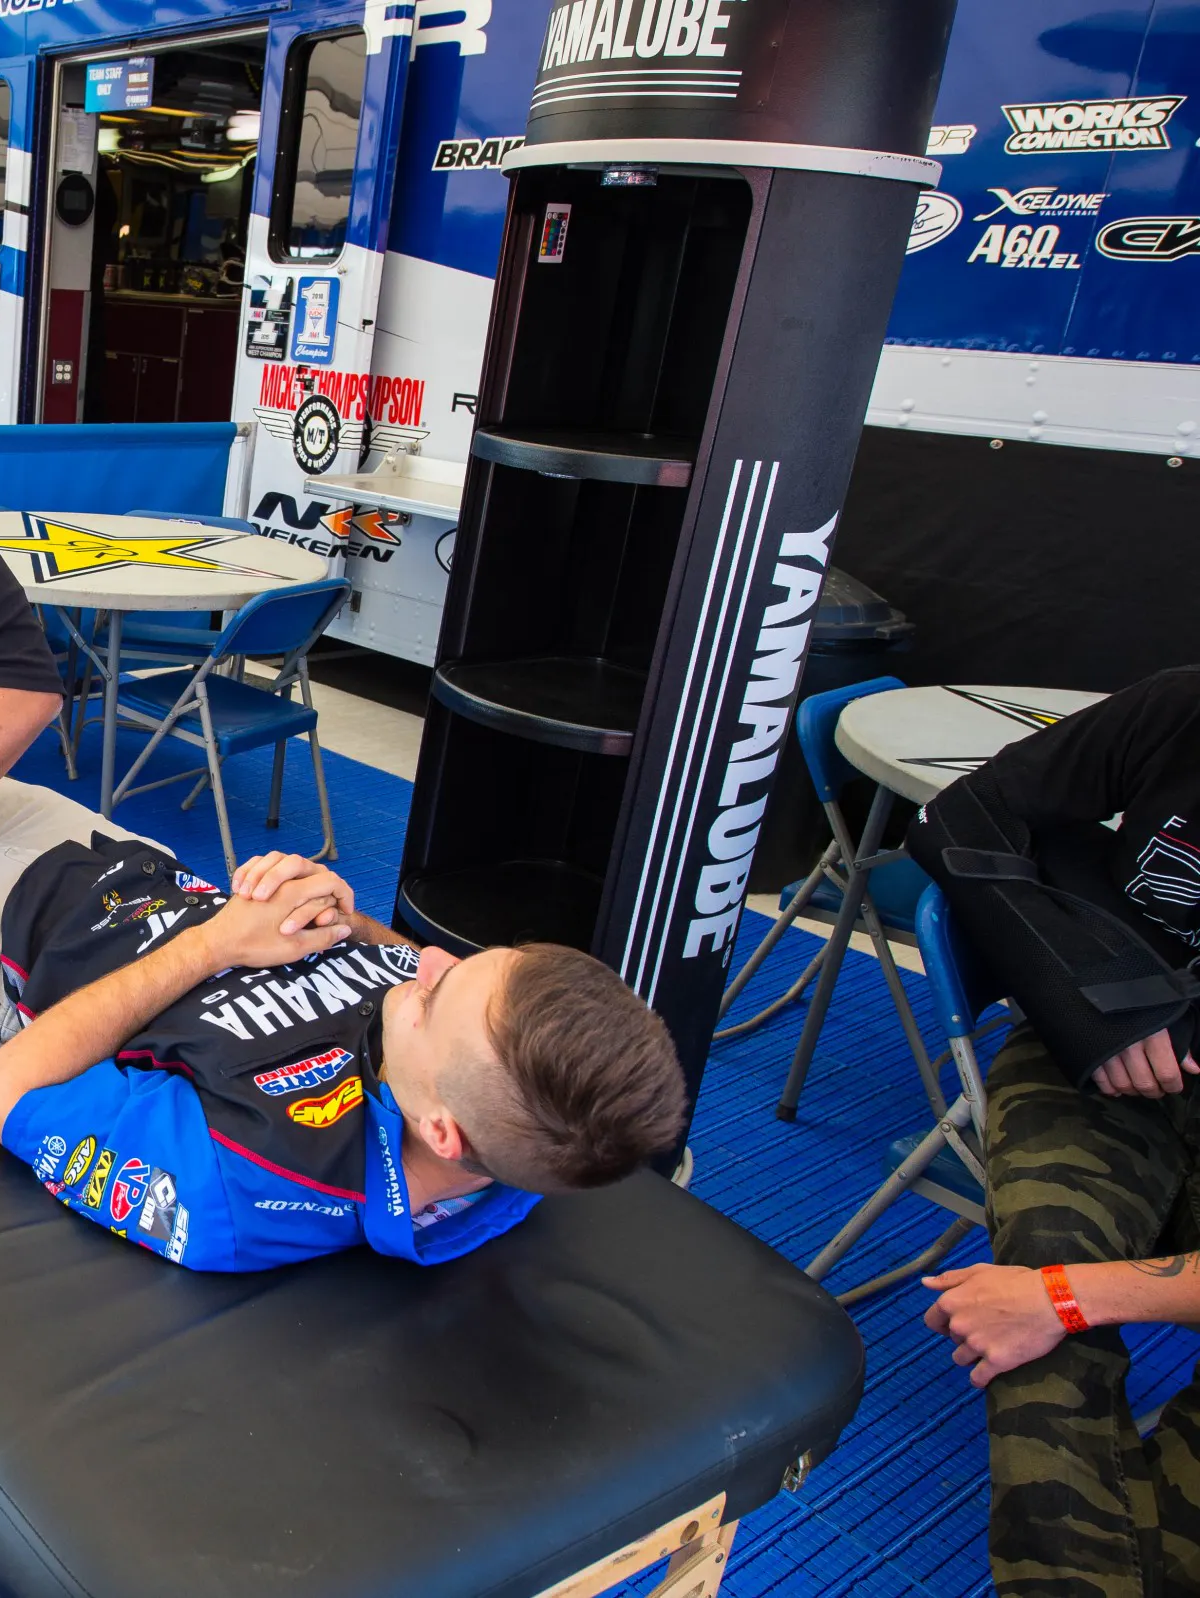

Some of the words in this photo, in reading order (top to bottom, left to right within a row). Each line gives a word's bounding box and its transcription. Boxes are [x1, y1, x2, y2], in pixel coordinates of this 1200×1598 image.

[542, 0, 731, 71] YAMALUBE
[105, 66, 123, 80] STAFF
[1008, 100, 1178, 133] WORKS
[1008, 127, 1162, 150] CONNECTION
[972, 186, 1107, 222] XCELDYNE
[1039, 209, 1099, 217] VALVETRAIN
[966, 224, 1061, 264] A60
[1000, 253, 1082, 269] EXCEL
[295, 344, 329, 359] Champion
[681, 508, 840, 960] YAMALUBE
[198, 948, 404, 1041] YAMAHA
[254, 1048, 347, 1085] UNLIMITED
[261, 1052, 355, 1096] PARTS
[292, 1079, 363, 1125] FMF
[65, 1137, 91, 1186] ARC
[383, 1146, 405, 1217] YAMAHA
[253, 1199, 345, 1217] DUNLOP
